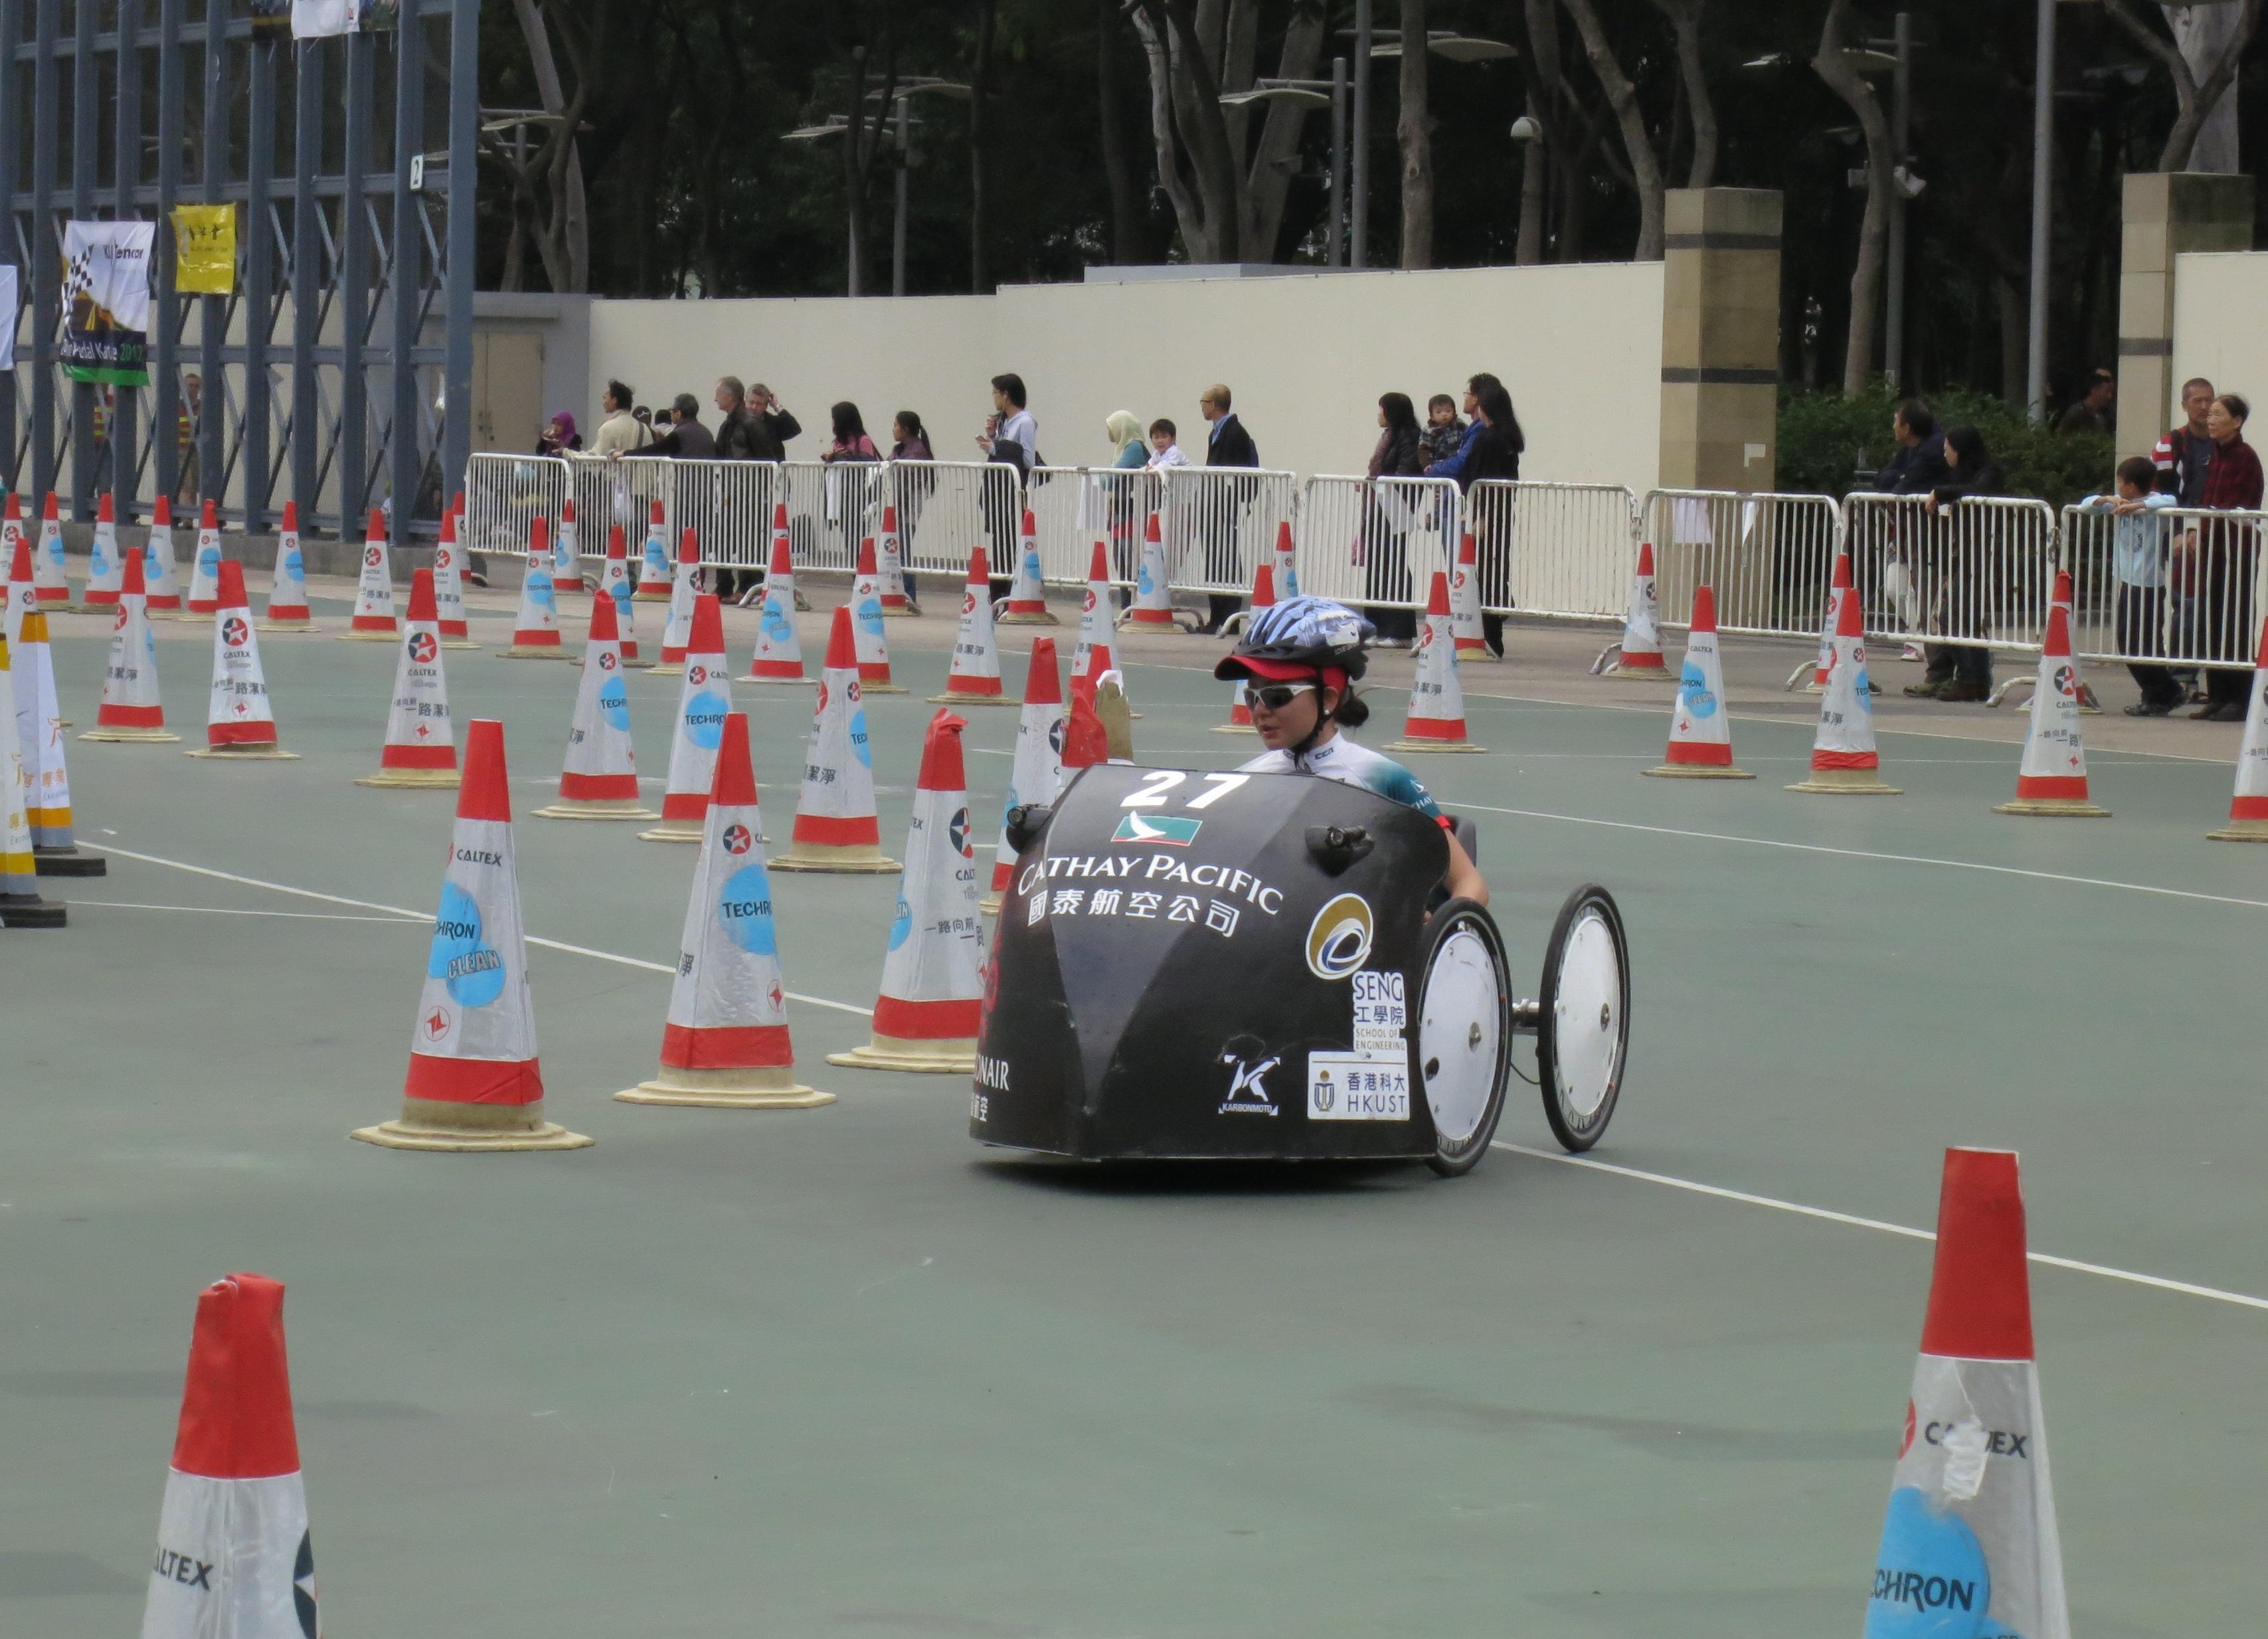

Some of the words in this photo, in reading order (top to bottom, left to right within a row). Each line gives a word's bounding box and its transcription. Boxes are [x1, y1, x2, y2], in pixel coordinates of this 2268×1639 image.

[408, 668, 437, 677] CALTEX
[1120, 771, 1251, 809] 27
[457, 849, 503, 867] CALTEX
[1018, 856, 1144, 897] CATHAY
[1144, 854, 1284, 916] PACIFIC
[1028, 888, 1241, 938] 國泰航空公司
[924, 917, 974, 934] 一路向前
[447, 949, 501, 980] CLEAN
[1355, 974, 1403, 1002] SENG
[1356, 1005, 1405, 1025] 工學院
[1355, 1029, 1387, 1039] SCHOOL
[1389, 1029, 1398, 1039] OF
[1355, 1040, 1405, 1051] ENGINEERING
[1348, 1072, 1405, 1092] 香港科大
[1348, 1095, 1405, 1113] HKUST
[1925, 1422, 2028, 1460] CEX
[1870, 1569, 1976, 1614] CHRON
